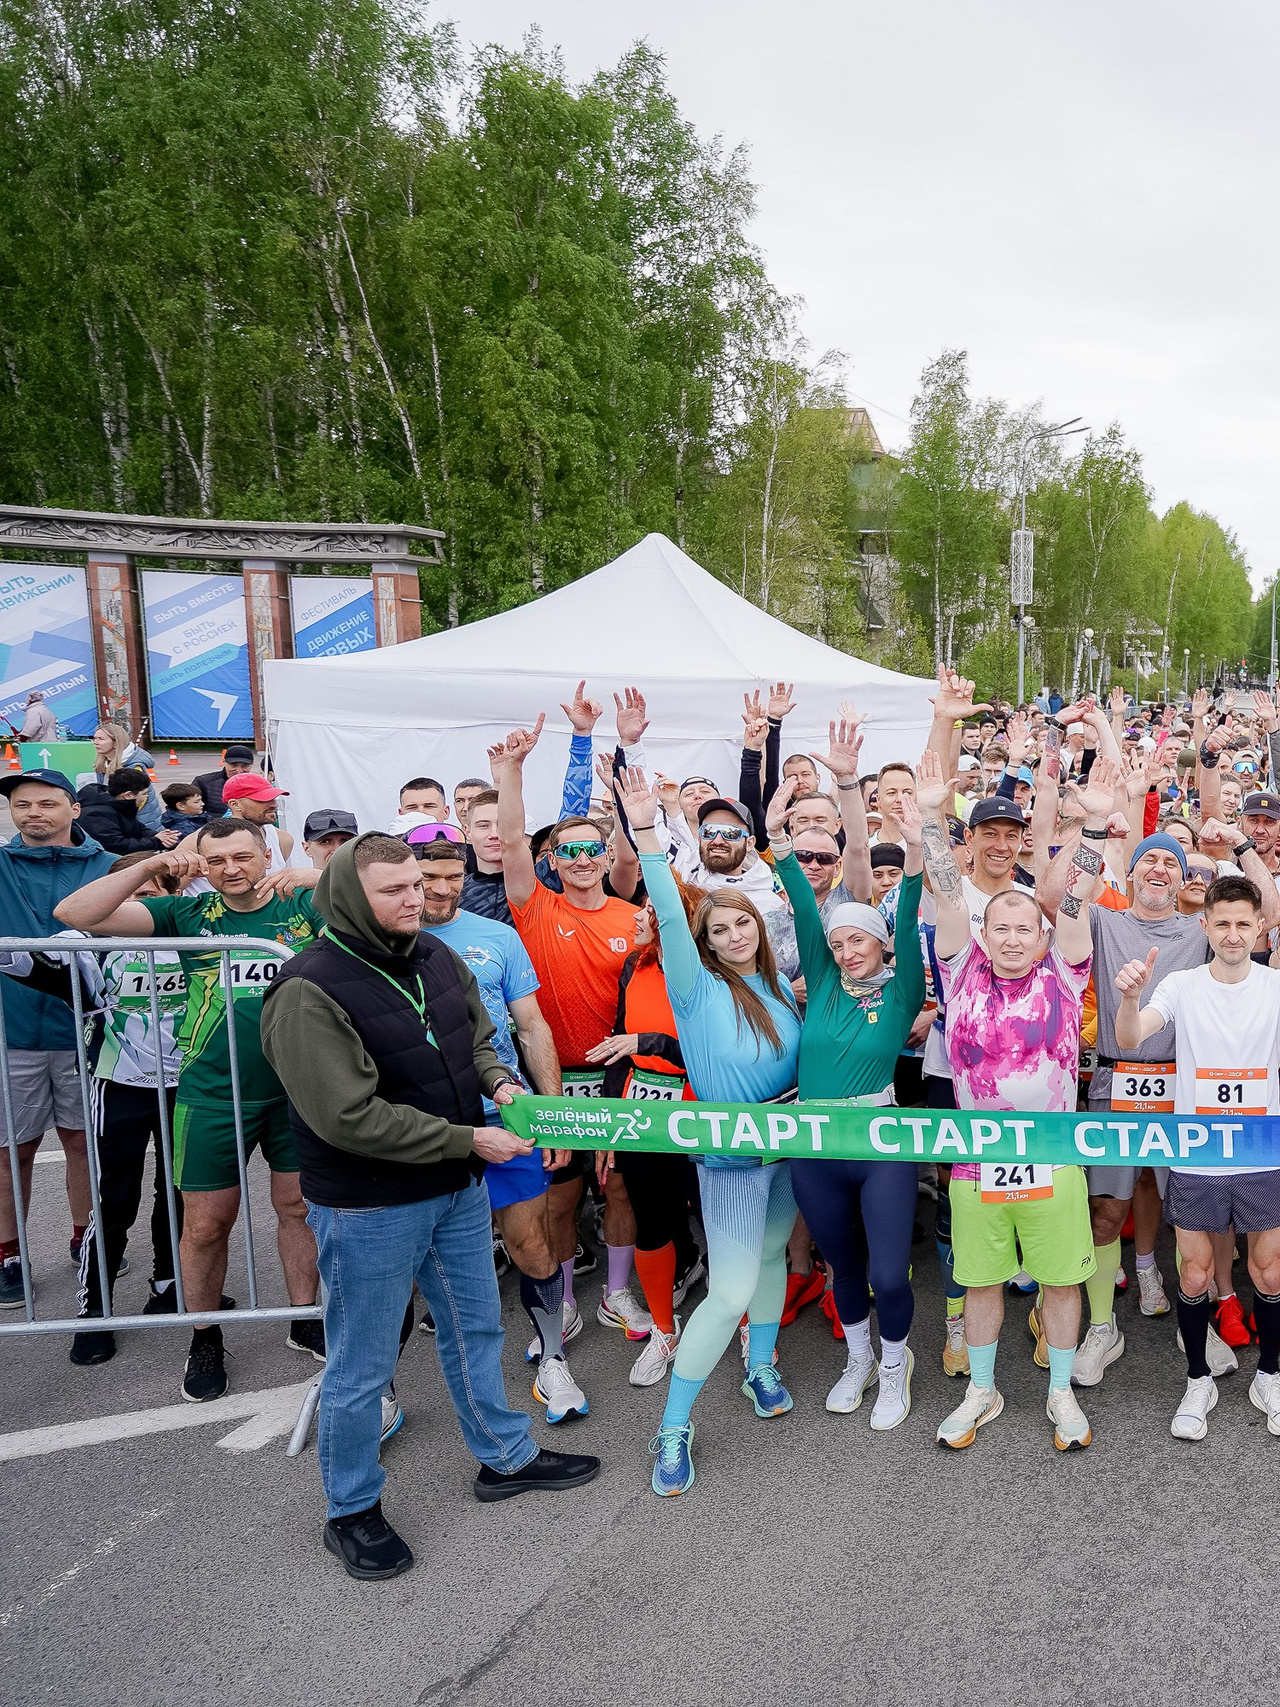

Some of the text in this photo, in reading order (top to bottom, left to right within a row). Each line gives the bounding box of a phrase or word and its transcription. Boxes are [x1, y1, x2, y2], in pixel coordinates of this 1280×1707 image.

[0, 575, 36, 595] ЫТЬ
[153, 582, 236, 624] БЫТЬ ВМЕСТЕ
[300, 587, 357, 621] ФЕСТИВАЛЬ
[173, 621, 238, 654] С РОССИЕЙ
[183, 620, 216, 639] БЫТЬ
[307, 610, 370, 653] ДВИЖЕНИЕ
[315, 627, 374, 657] РВЫХ
[160, 648, 234, 686] БЫТЬ ПОЛЕЗНЫМ
[0, 674, 88, 716] ЫТЬ ЕЛЫМ
[608, 936, 628, 953] 10
[1125, 1077, 1166, 1097] 363
[1217, 1083, 1243, 1104] 81
[535, 1107, 612, 1124] зелёный
[529, 1123, 609, 1139] марафон
[667, 1110, 831, 1152] СТАРТ
[869, 1116, 1035, 1156] СТАРТ
[1074, 1121, 1244, 1158] СТАРТ
[994, 1164, 1035, 1187] 241
